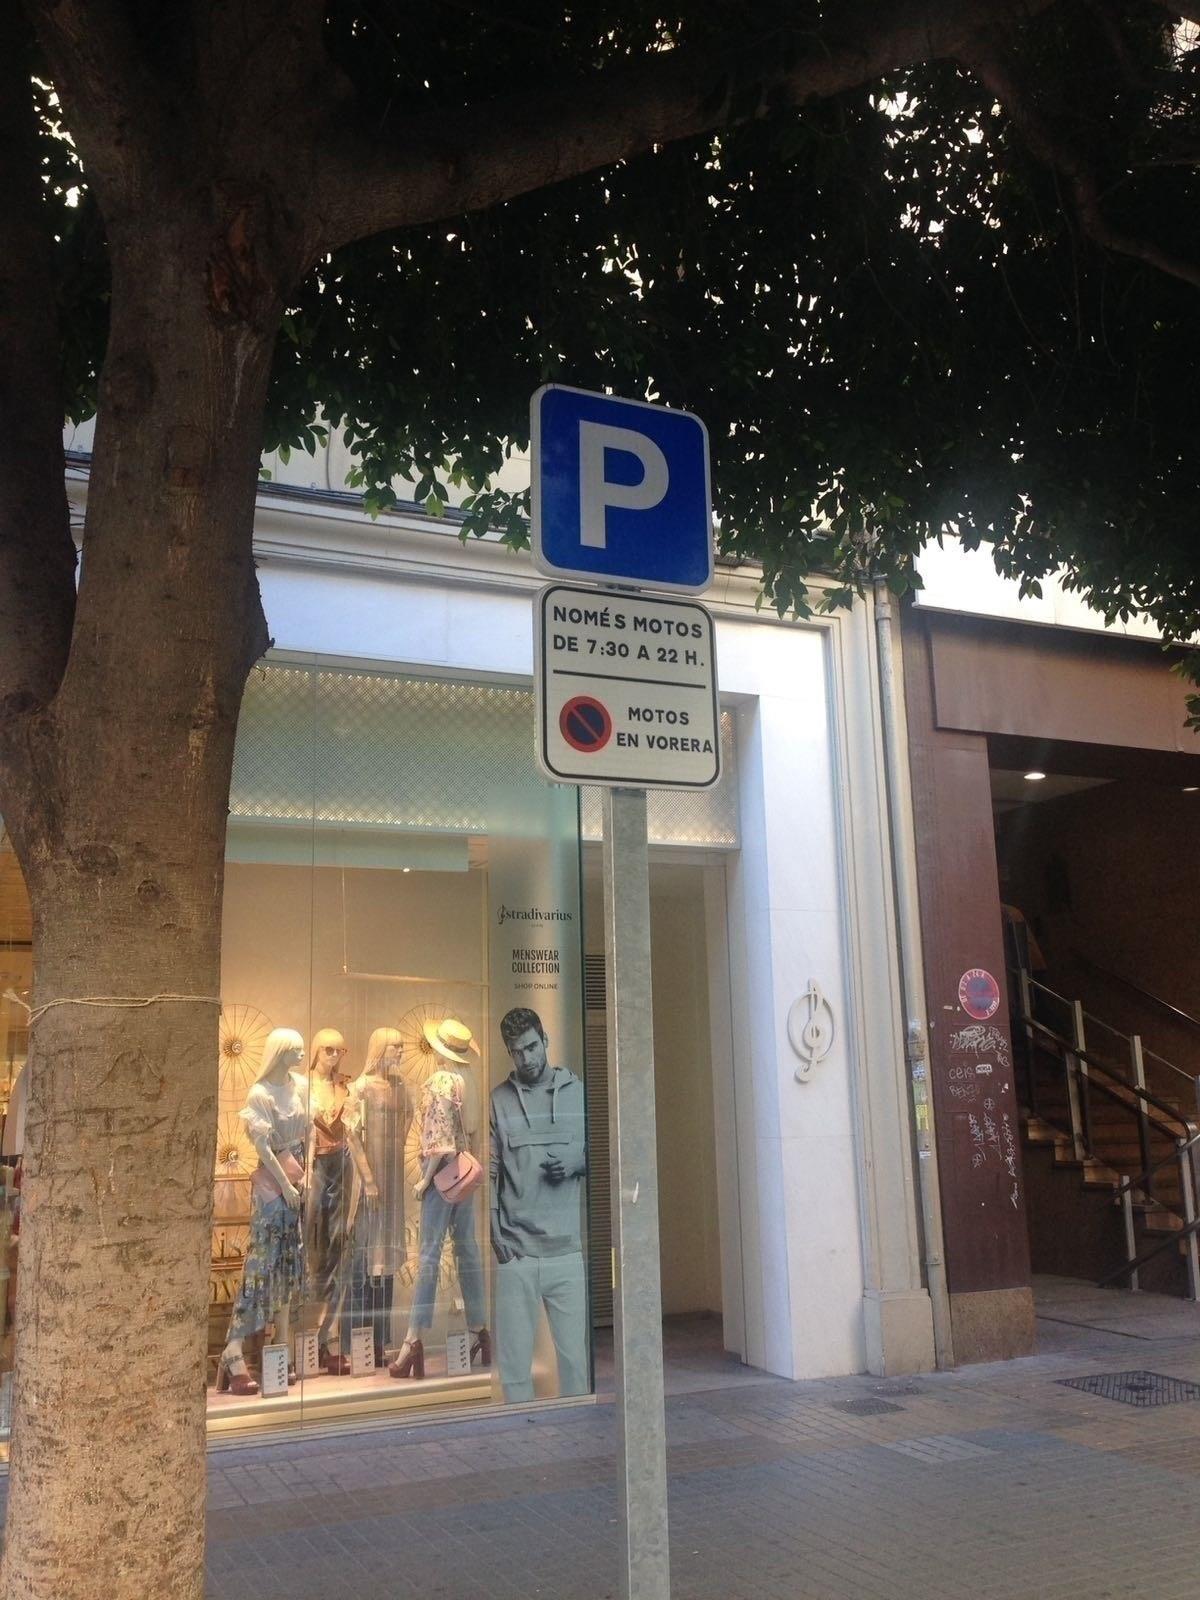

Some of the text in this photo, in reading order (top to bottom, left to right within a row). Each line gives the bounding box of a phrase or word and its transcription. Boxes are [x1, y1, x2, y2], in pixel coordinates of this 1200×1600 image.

[579, 419, 670, 549] P
[553, 605, 703, 639] NOMÉS MOTOS
[553, 634, 705, 666] DE 7:30 A 22 H.
[628, 706, 690, 726] MOTOS
[616, 732, 714, 754] EN VORERA
[512, 948, 560, 961] MENSWEAR
[511, 961, 560, 974] COLLECTION
